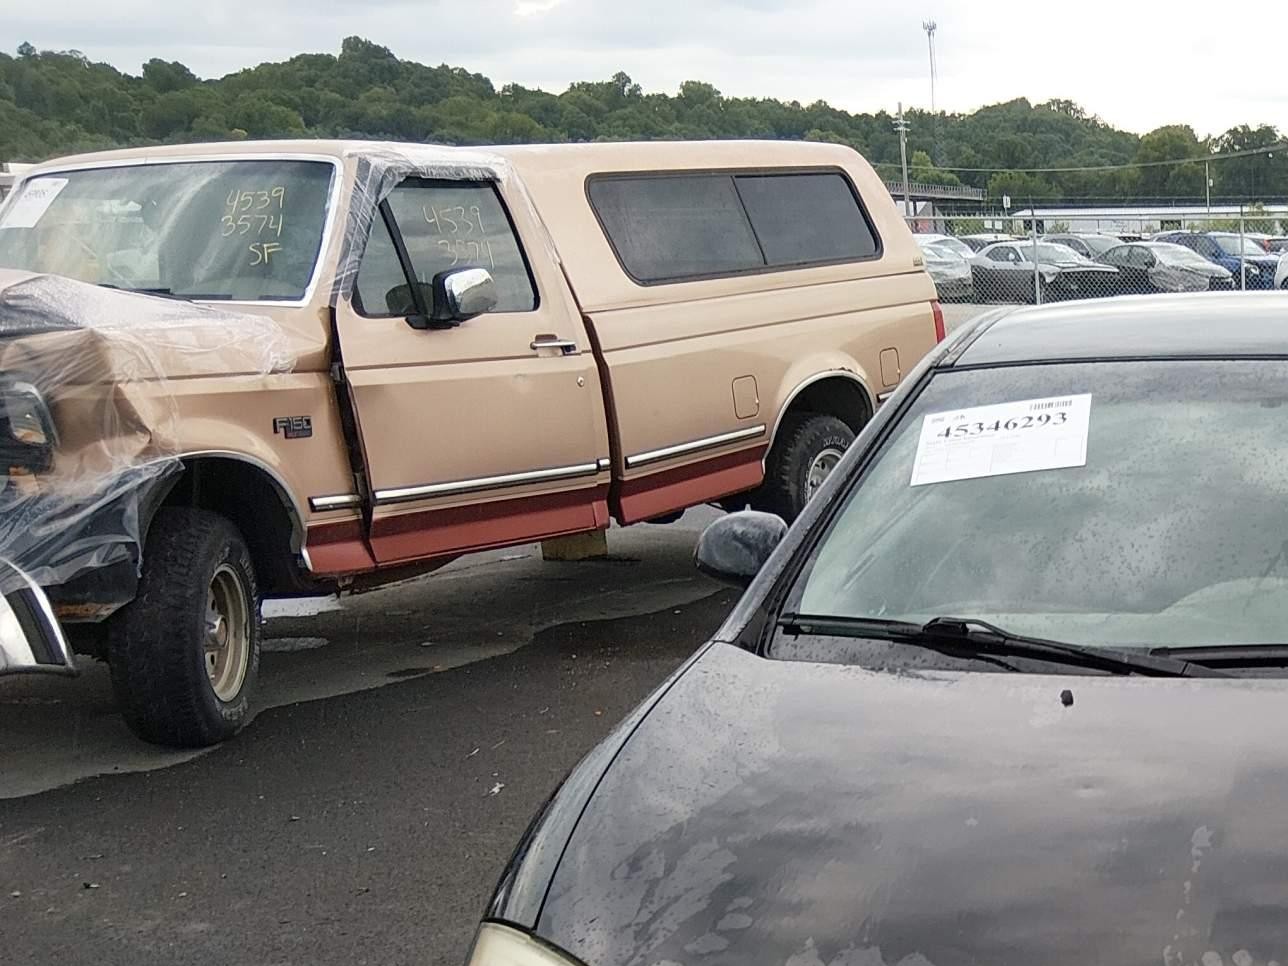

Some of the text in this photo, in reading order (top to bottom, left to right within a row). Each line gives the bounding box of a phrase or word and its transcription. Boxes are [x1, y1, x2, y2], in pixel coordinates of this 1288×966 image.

[226, 186, 285, 214] 4539
[221, 214, 283, 237] 3574
[422, 205, 485, 234] 4539
[248, 242, 283, 266] SF
[936, 411, 1068, 439] 45346293
